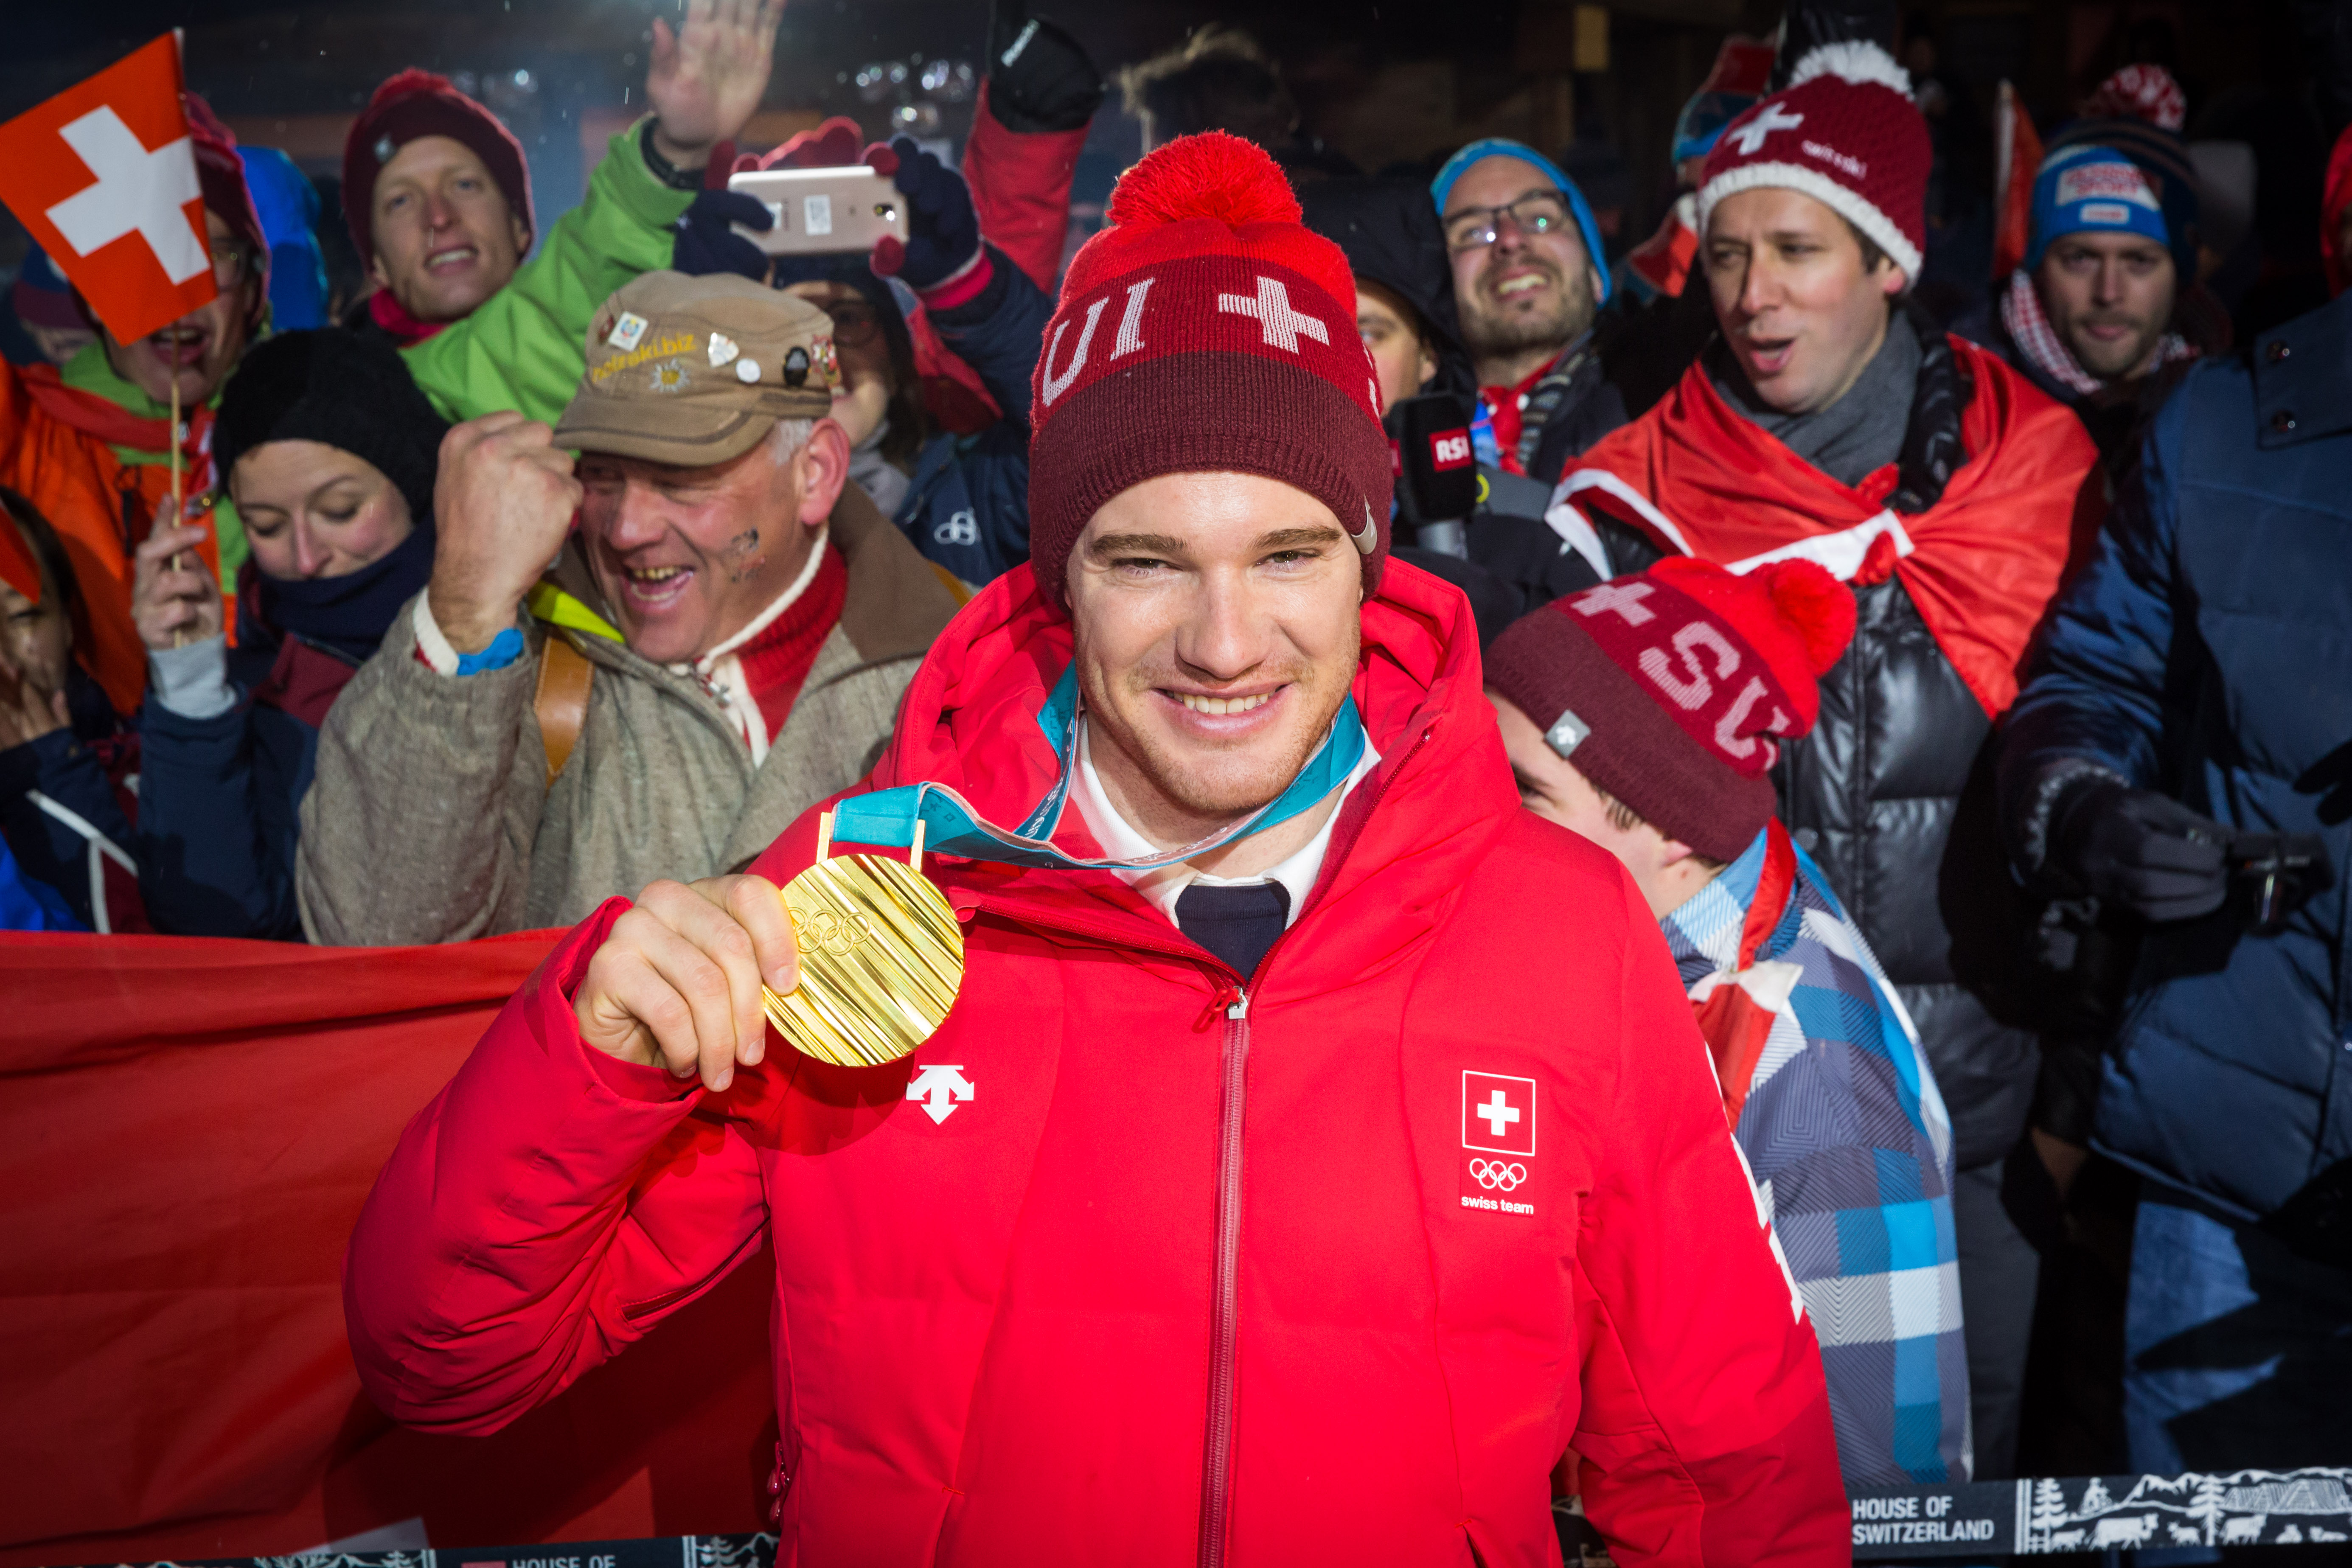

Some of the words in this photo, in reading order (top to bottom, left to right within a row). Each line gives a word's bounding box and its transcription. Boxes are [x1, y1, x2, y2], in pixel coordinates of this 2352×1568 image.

[1435, 435, 1470, 463] RSI
[1462, 1196, 1498, 1209] swiss
[1500, 1199, 1534, 1214] team
[1852, 1497, 1919, 1520] HOUSE
[1925, 1496, 1953, 1518] OF
[1852, 1519, 1994, 1545] SWITZERLAND
